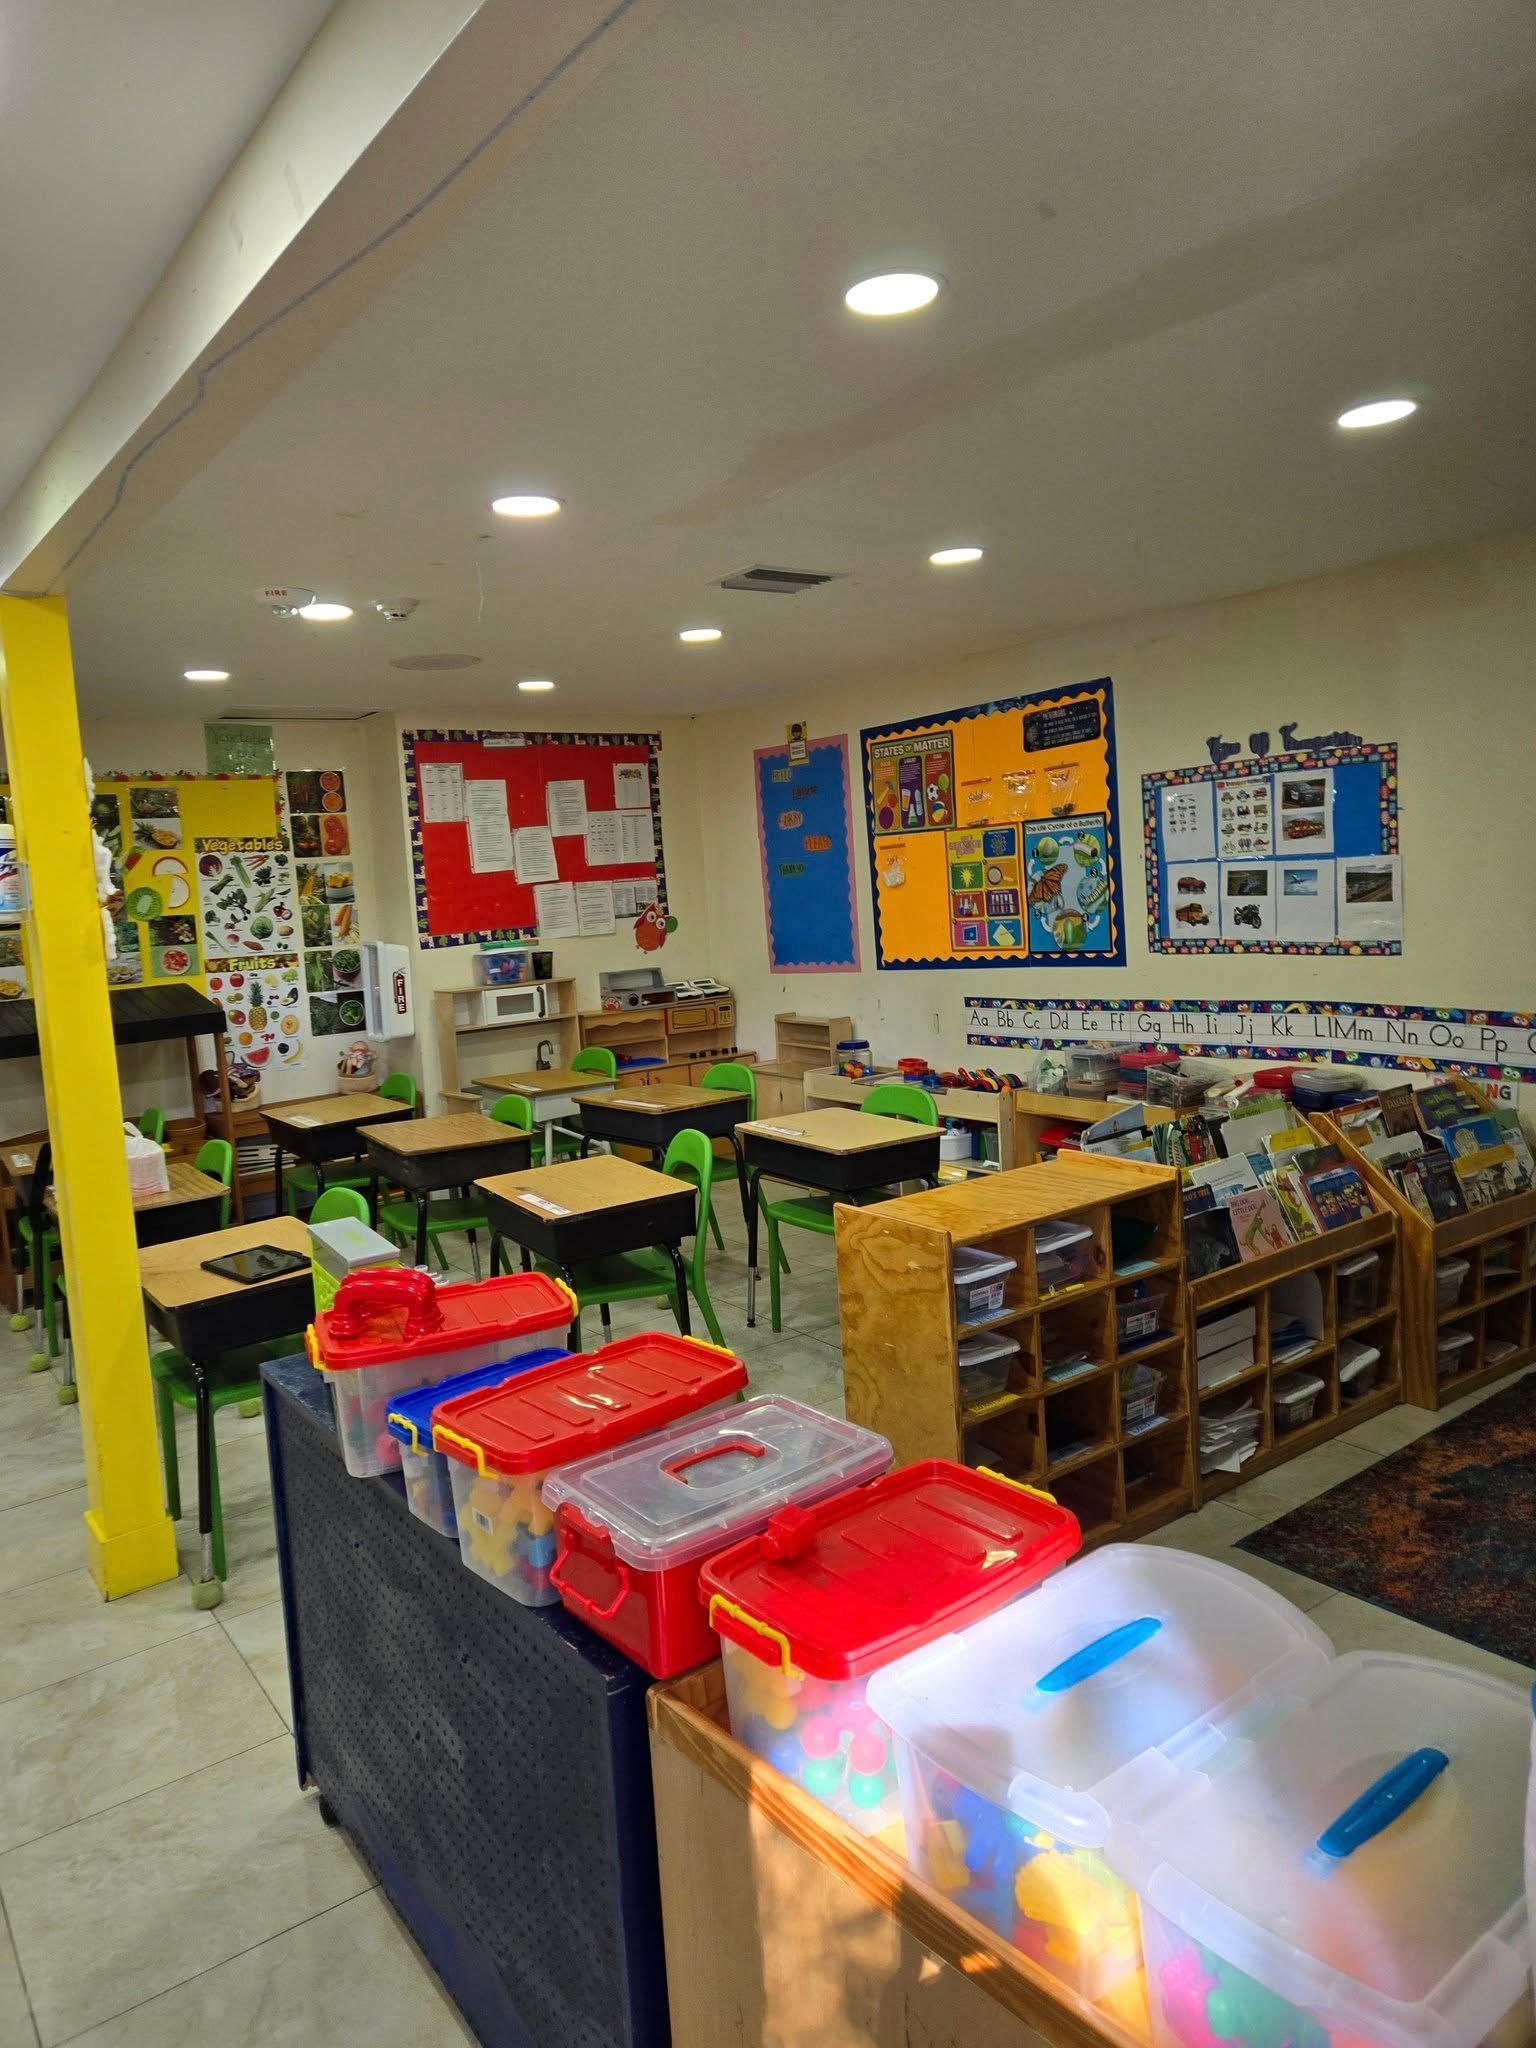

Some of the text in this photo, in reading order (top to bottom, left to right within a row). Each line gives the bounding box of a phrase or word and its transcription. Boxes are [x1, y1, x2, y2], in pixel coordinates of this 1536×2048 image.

[264, 589, 288, 597] FIRE
[874, 744, 904, 758] STATES
[913, 737, 950, 753] MATTER
[1048, 821, 1066, 832] Cycle
[201, 838, 284, 856] Vegetables
[228, 958, 276, 972] Fruits
[397, 979, 406, 1012] FIRE
[970, 1009, 989, 1027] Aa
[996, 1010, 1014, 1028] Bb
[1023, 1011, 1040, 1030] Cc
[1050, 1011, 1069, 1030] Dd
[1081, 1012, 1098, 1031] Ee
[1110, 1012, 1125, 1031] Ff
[1137, 1013, 1161, 1041] Gg
[1171, 1013, 1194, 1034] Hh
[1205, 1014, 1218, 1034] Ii
[1234, 1014, 1253, 1044] Jj
[1271, 1015, 1294, 1036] Kk
[1334, 1017, 1373, 1041] Mm
[1387, 1020, 1418, 1045] Nn
[1429, 1024, 1465, 1049] Oo
[1480, 1027, 1508, 1062] Pp
[1232, 1206, 1248, 1216] LITTLE
